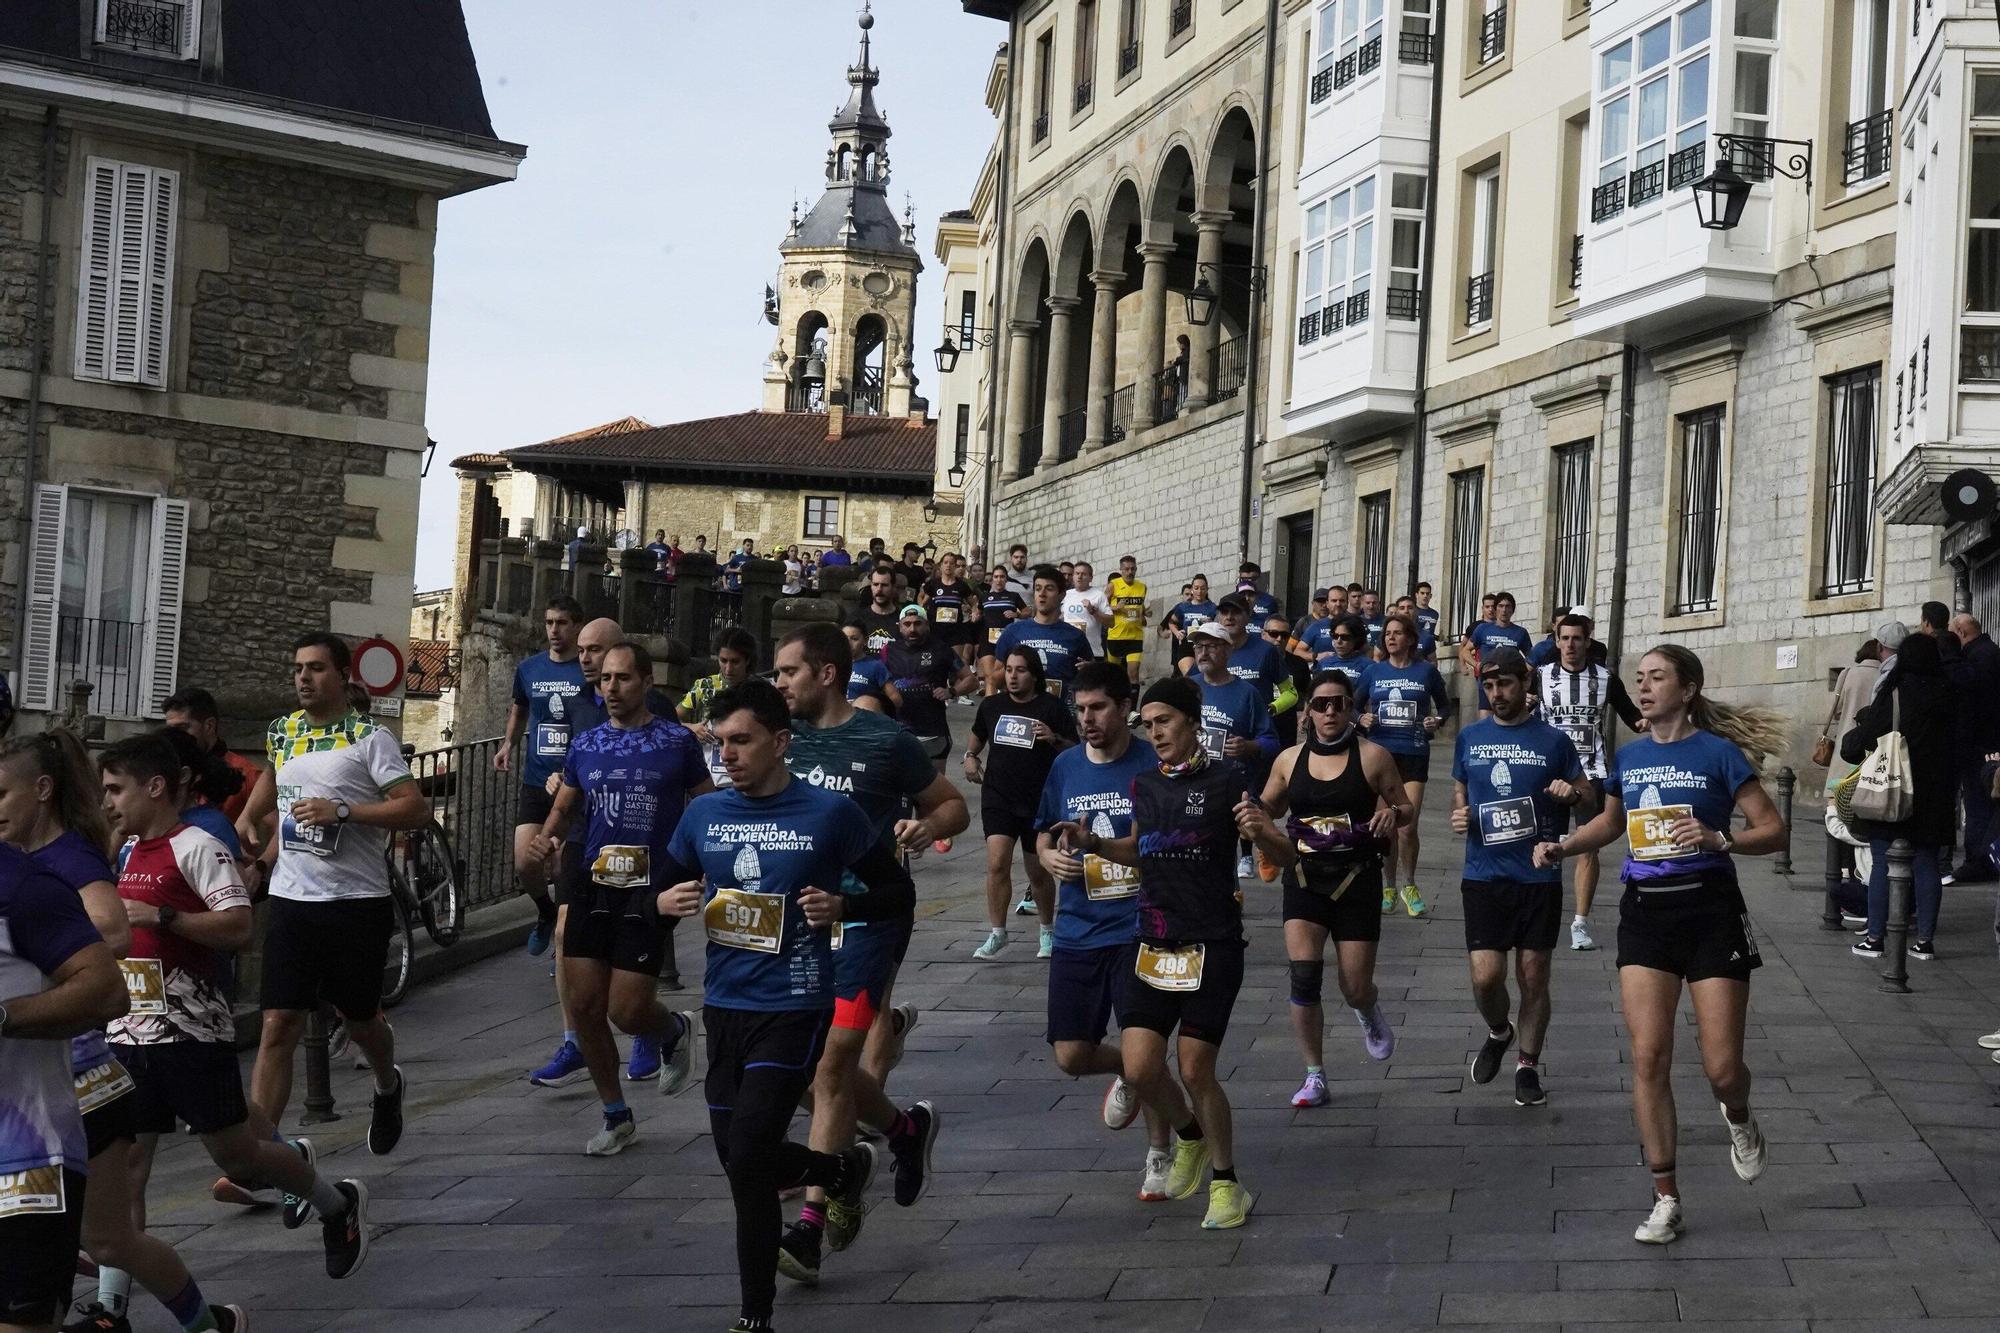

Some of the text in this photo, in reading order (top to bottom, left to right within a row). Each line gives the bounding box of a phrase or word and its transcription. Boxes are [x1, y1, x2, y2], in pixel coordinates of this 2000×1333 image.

[1386, 706, 1409, 717] 1084
[1006, 722, 1026, 736] 923
[547, 731, 568, 744] 990
[1479, 750, 1537, 759] ALMENDRA
[1509, 758, 1547, 767] KONKISTA
[1629, 765, 1675, 776] CONQUISTA
[1628, 771, 1693, 784] ALMENDRA
[1660, 781, 1707, 790] KONKISTA
[625, 793, 658, 803] VITORIA
[1074, 791, 1121, 804] CONQUISTA
[624, 802, 657, 811] GASTEIZ
[1186, 805, 1204, 816] OTSO
[1492, 809, 1521, 828] 855
[708, 823, 778, 832] LA CONQUISTA
[720, 830, 798, 842] ALMENDRA
[760, 842, 814, 851] KONKISTA
[605, 855, 635, 873] 466
[1101, 862, 1134, 881] 582
[725, 903, 761, 928] 597
[1153, 956, 1188, 975] 498
